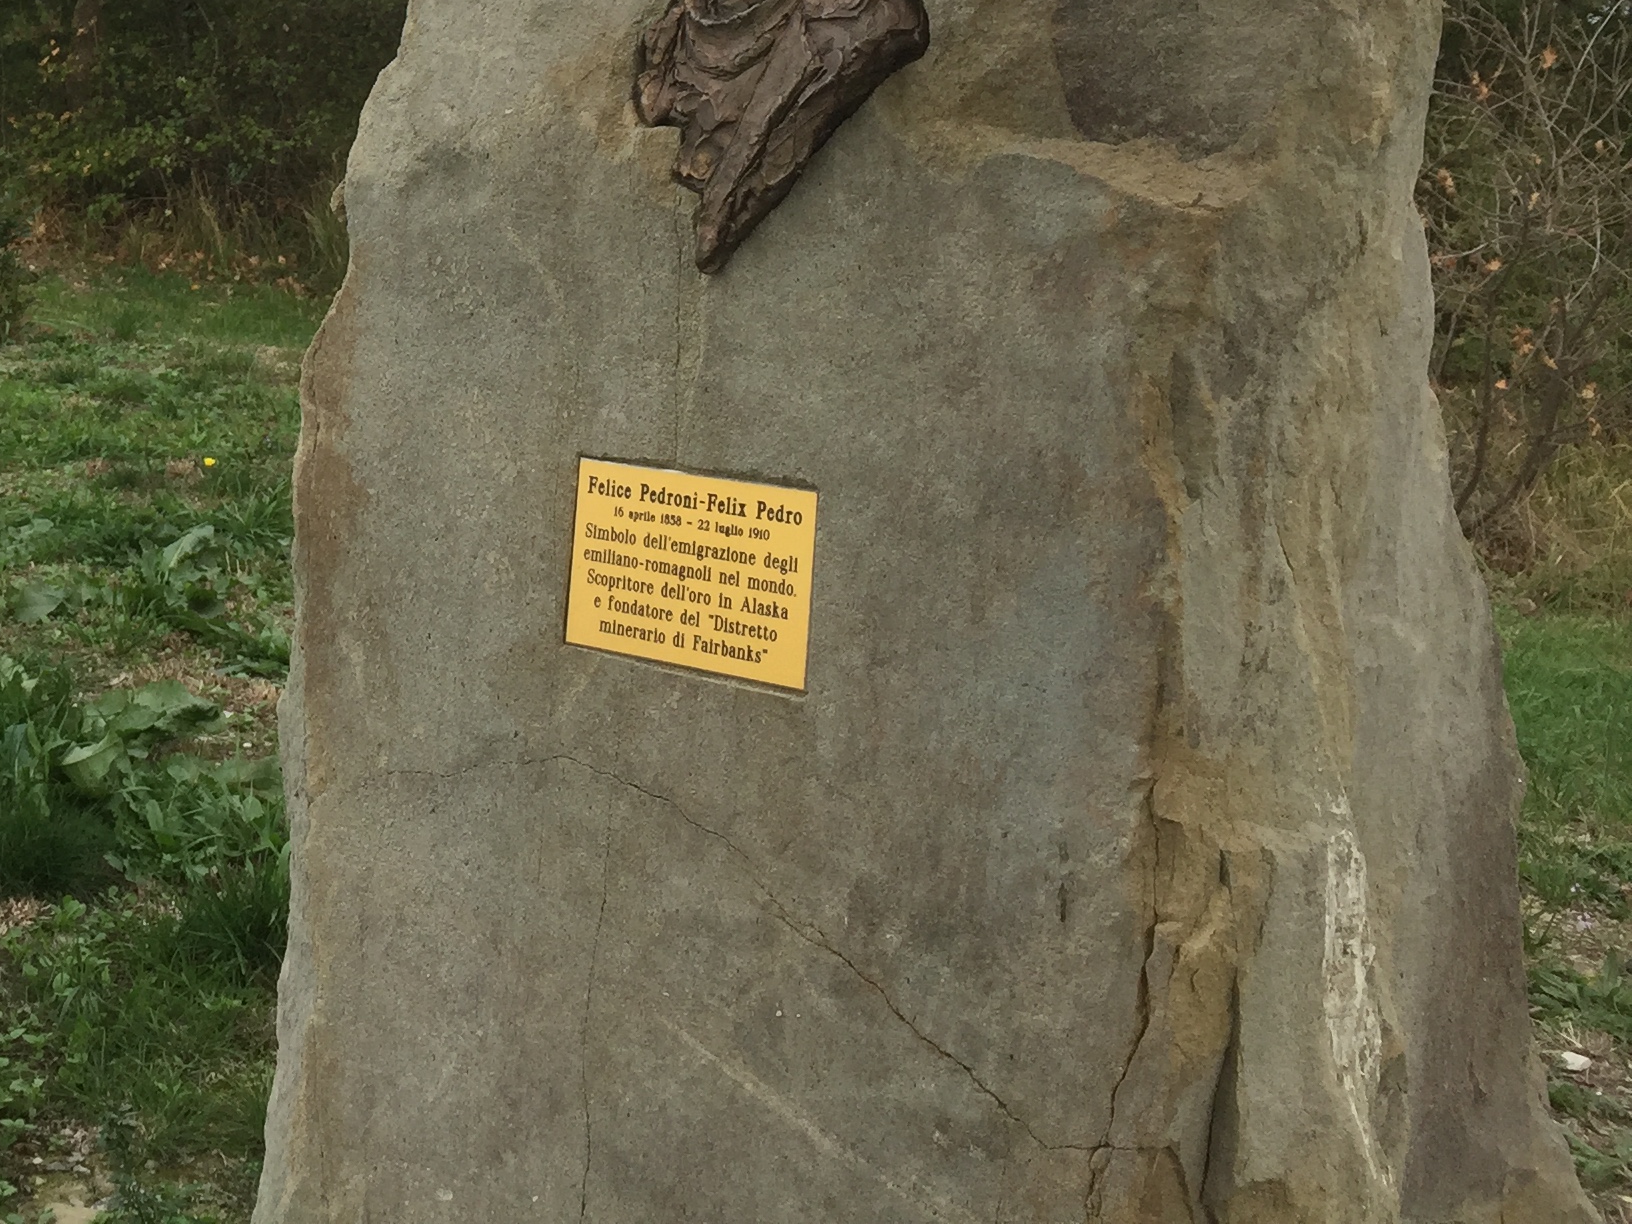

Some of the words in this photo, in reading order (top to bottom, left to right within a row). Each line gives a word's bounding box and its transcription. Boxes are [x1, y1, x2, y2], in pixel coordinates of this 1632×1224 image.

[588, 476, 632, 499] Felice
[639, 483, 747, 518] Pedroni-Felix
[756, 501, 803, 526] Pedro
[614, 506, 624, 518] 16
[629, 510, 655, 522] aprile
[660, 514, 682, 526] 1858
[697, 519, 710, 532] 22
[715, 522, 744, 537] luglio
[748, 527, 770, 541] 1910
[583, 548, 712, 581] emiliano-romagnoli
[719, 572, 740, 587] nel
[747, 577, 797, 597] mondo.
[585, 523, 636, 545] Simbolo
[643, 532, 756, 566] dell'emigrazione
[763, 552, 798, 575] degli
[587, 568, 654, 595] Scopritore
[661, 582, 712, 605] dell'oro
[718, 592, 732, 609] in
[740, 596, 789, 620] Alaska
[593, 596, 601, 608] e
[607, 595, 674, 622] fondatore
[679, 609, 700, 627] del
[708, 614, 778, 642] "Distretto
[599, 619, 666, 644] minerario
[673, 632, 685, 648] di
[692, 635, 768, 664] Fairbanks"
